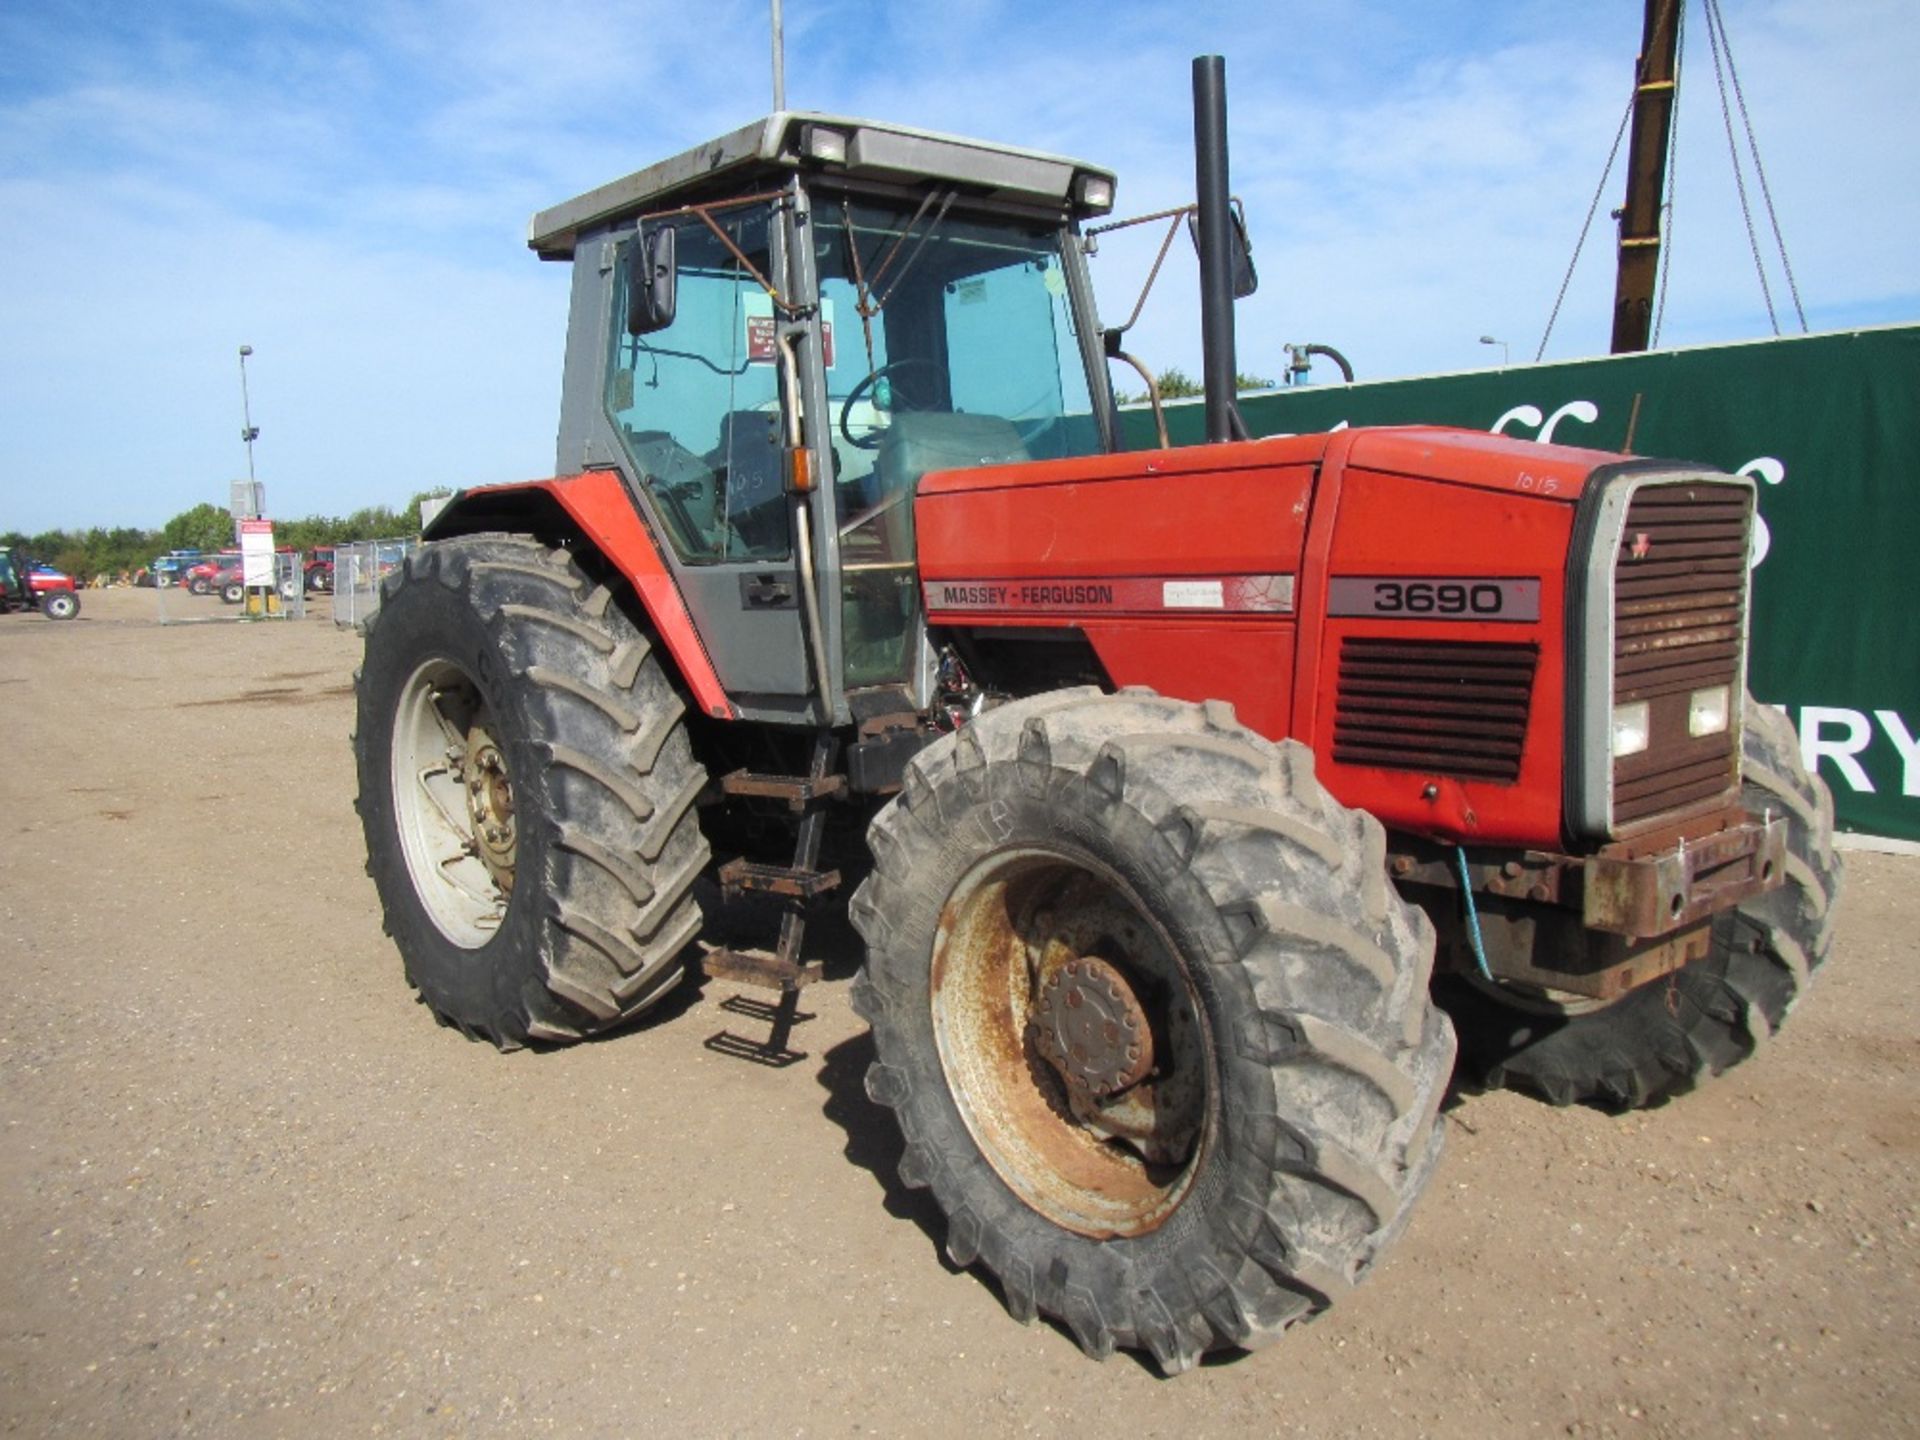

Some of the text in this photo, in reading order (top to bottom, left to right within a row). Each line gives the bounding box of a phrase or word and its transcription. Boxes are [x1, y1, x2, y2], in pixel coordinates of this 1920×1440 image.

[943, 587, 1007, 604] MASSEY
[1020, 585, 1113, 604] FERGUSON
[1373, 583, 1503, 614] 3690
